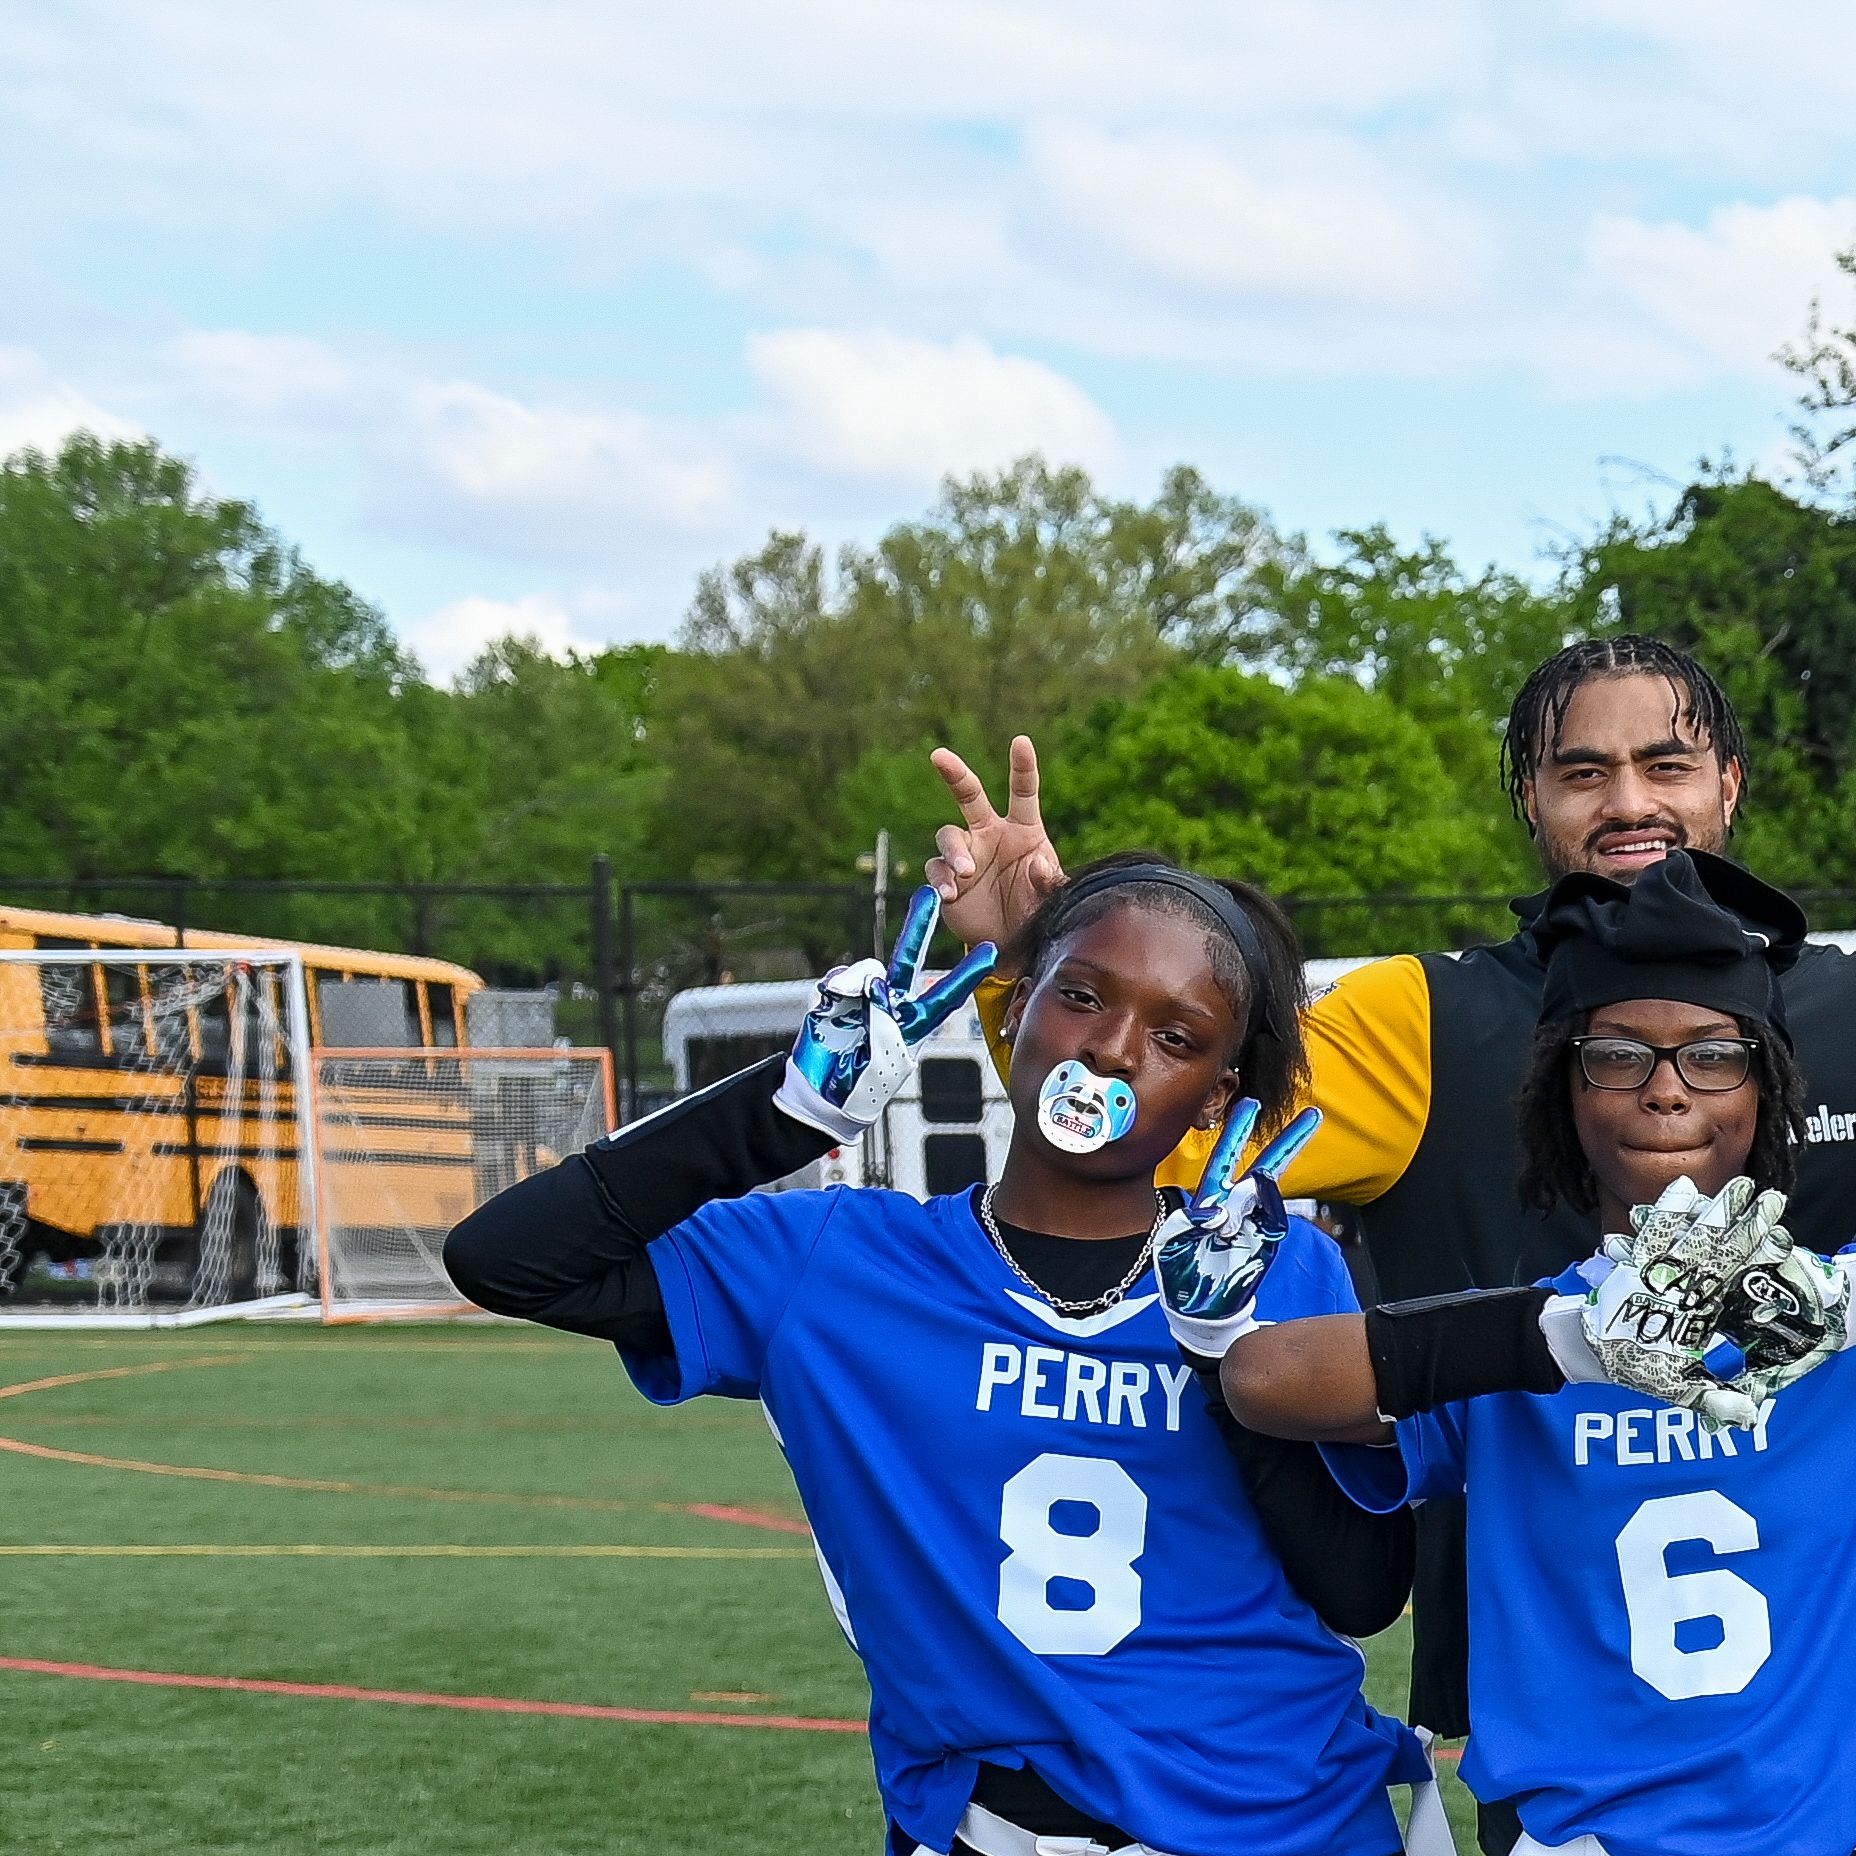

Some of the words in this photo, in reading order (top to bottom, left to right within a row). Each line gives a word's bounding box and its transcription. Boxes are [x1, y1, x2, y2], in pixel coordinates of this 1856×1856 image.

[1056, 1114, 1092, 1136] BATTLE
[975, 1341, 1195, 1432] PERRY
[997, 1452, 1148, 1656] 8
[1615, 1489, 1772, 1701] 6
